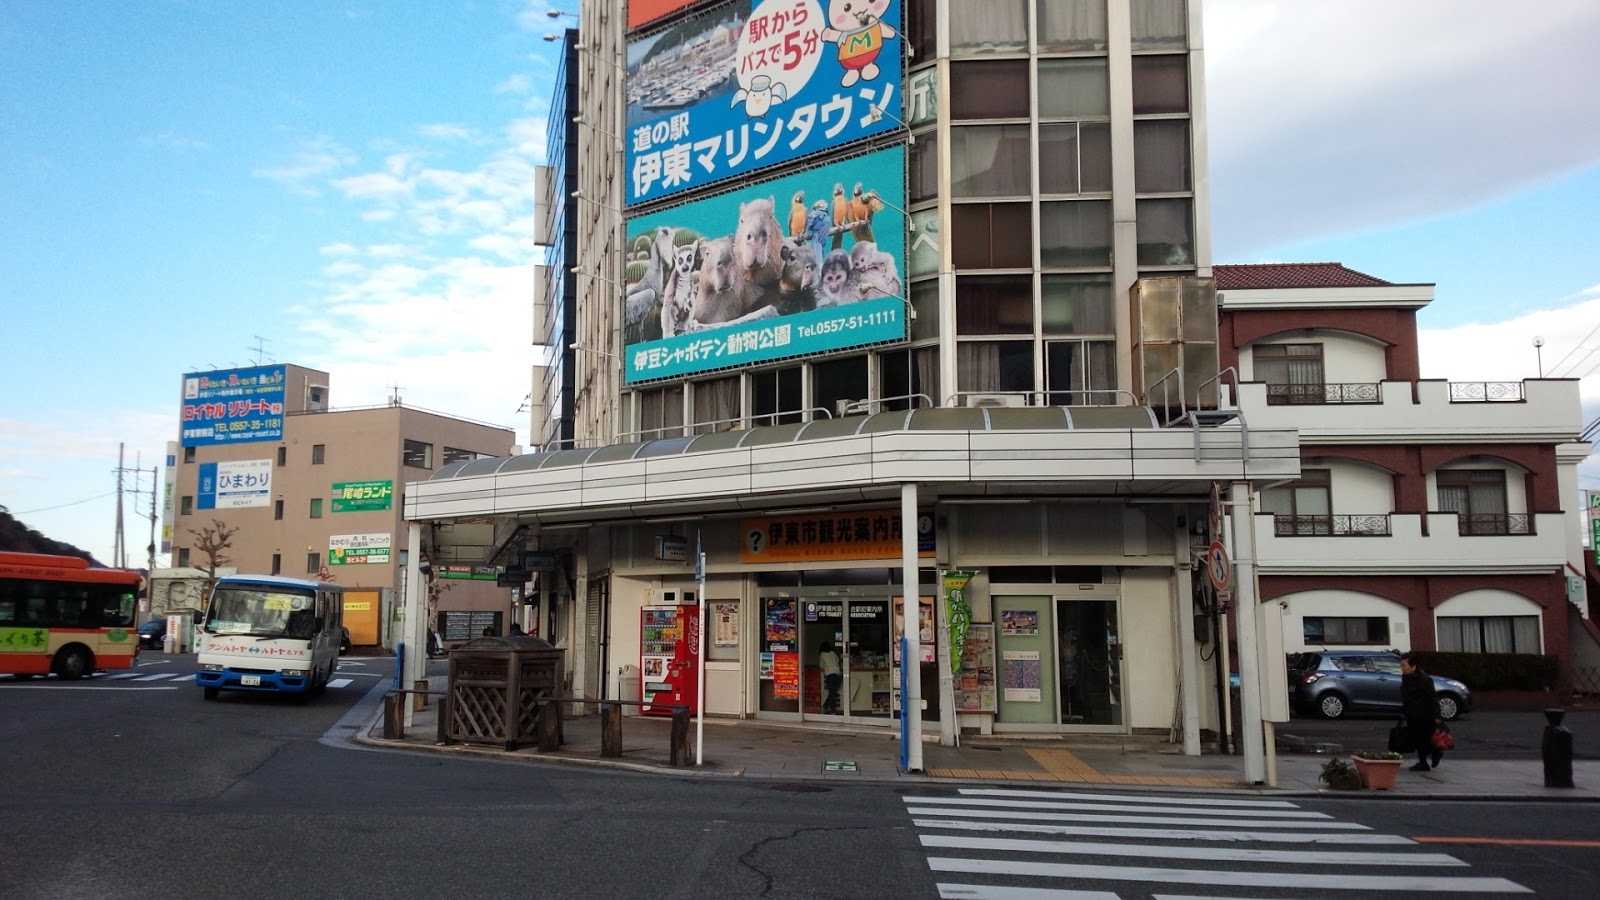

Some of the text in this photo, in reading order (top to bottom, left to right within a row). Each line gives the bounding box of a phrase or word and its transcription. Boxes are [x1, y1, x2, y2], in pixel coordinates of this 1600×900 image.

[749, 2, 808, 43] 駅から
[850, 32, 872, 53] M
[741, 29, 818, 75] バスで5分
[632, 83, 894, 198] 伊東マリンタウン
[633, 112, 690, 153] 道の駅
[634, 324, 792, 371] 伊豆シャボテン動物公園
[183, 402, 226, 421] ロイヤル
[219, 472, 269, 489] ひまわり
